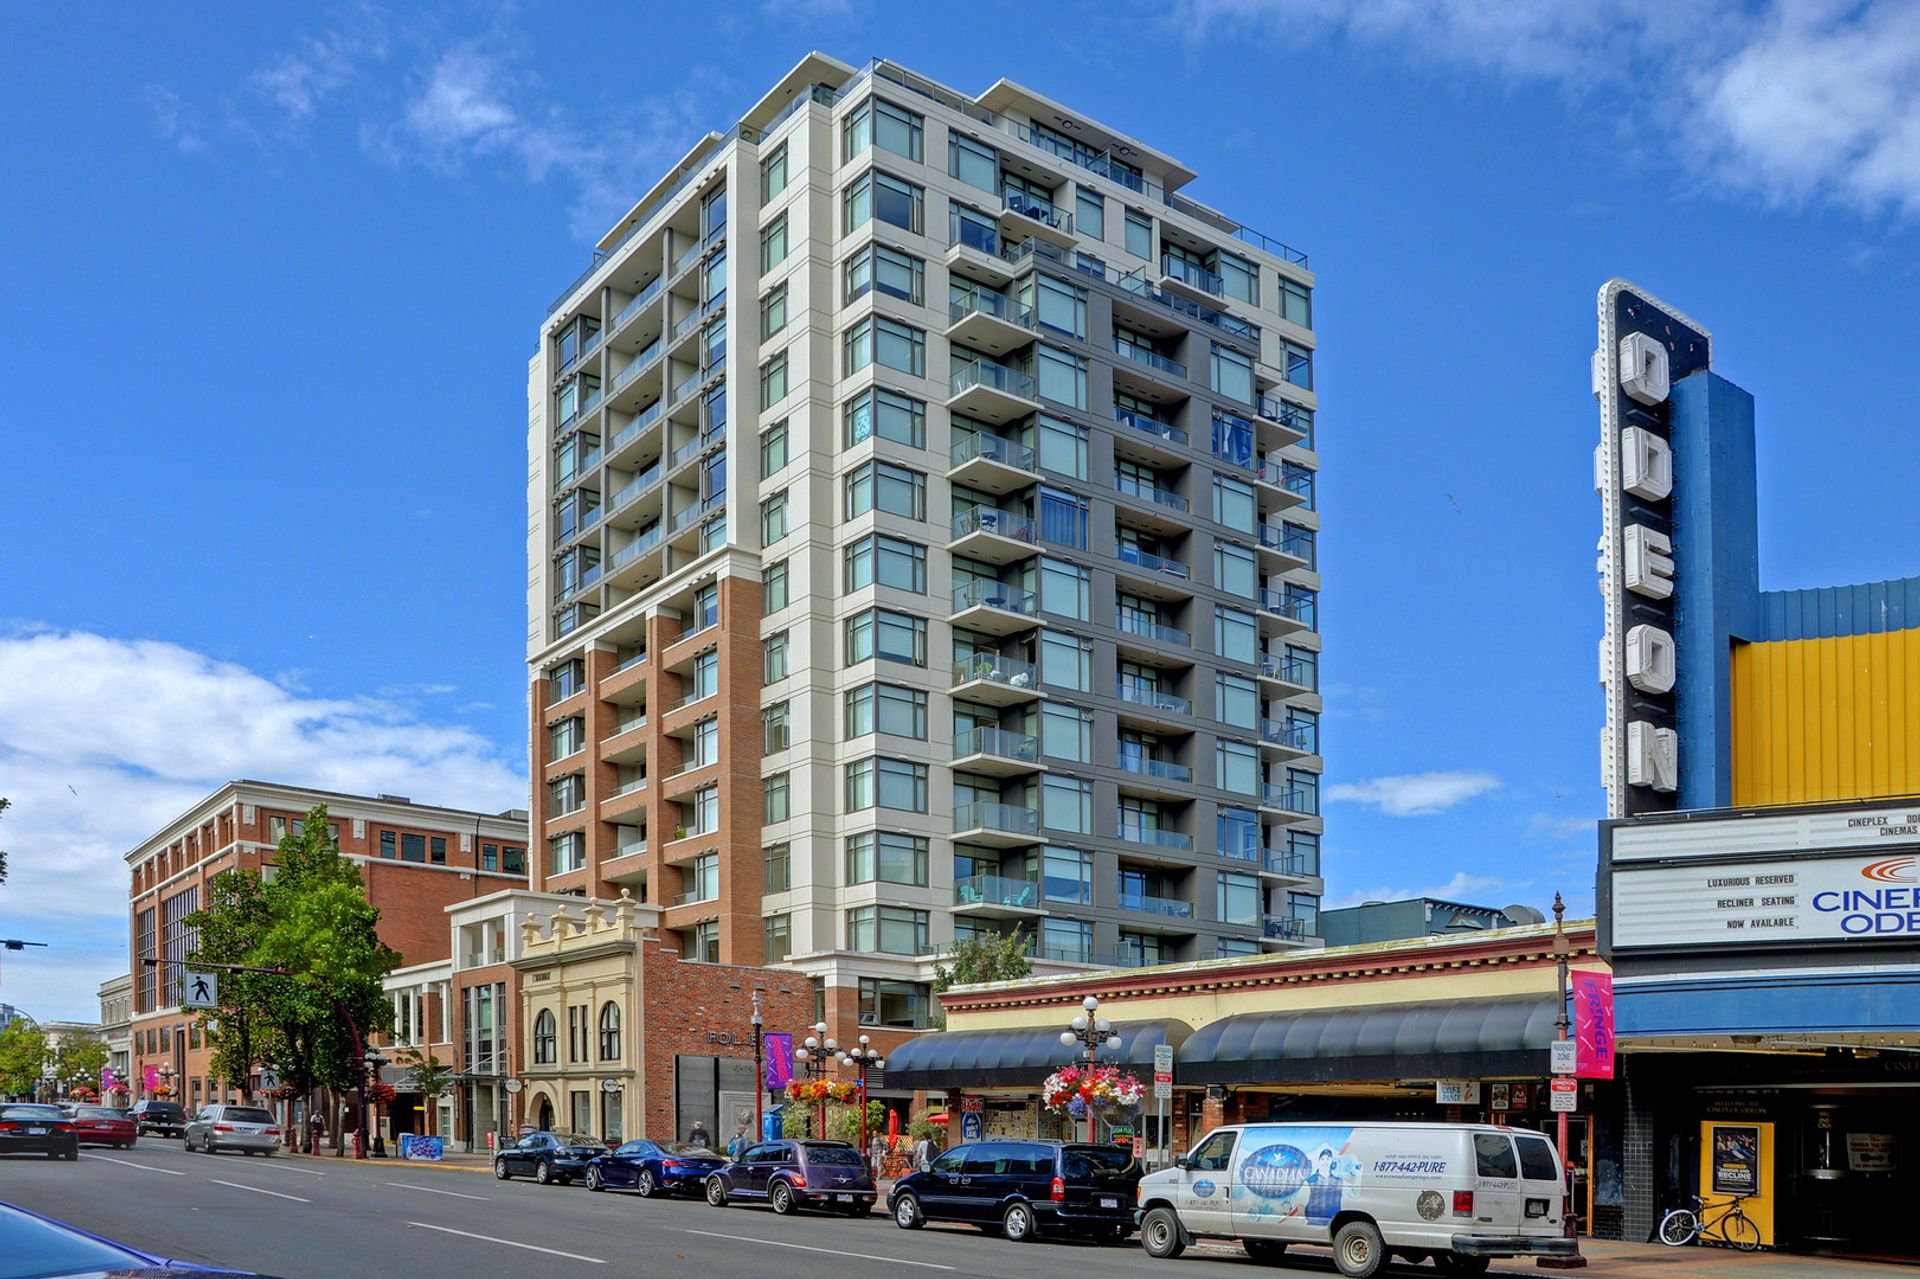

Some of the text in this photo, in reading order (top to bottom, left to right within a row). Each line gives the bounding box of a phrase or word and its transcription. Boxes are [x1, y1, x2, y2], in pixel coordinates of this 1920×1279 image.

[1619, 331, 1678, 793] ODEON
[1848, 816, 1888, 827] CINEPLEX
[1880, 825, 1918, 836] CINEMAS
[1707, 874, 1794, 888] LUXURIOUS RESERVED
[1717, 896, 1795, 909] RECLINER SEATING
[1727, 917, 1794, 930] NOW AVAILABLE
[707, 1030, 741, 1045] FOL
[1244, 1166, 1308, 1181] CANADIAN
[1718, 1172, 1752, 1180] RECLINE
